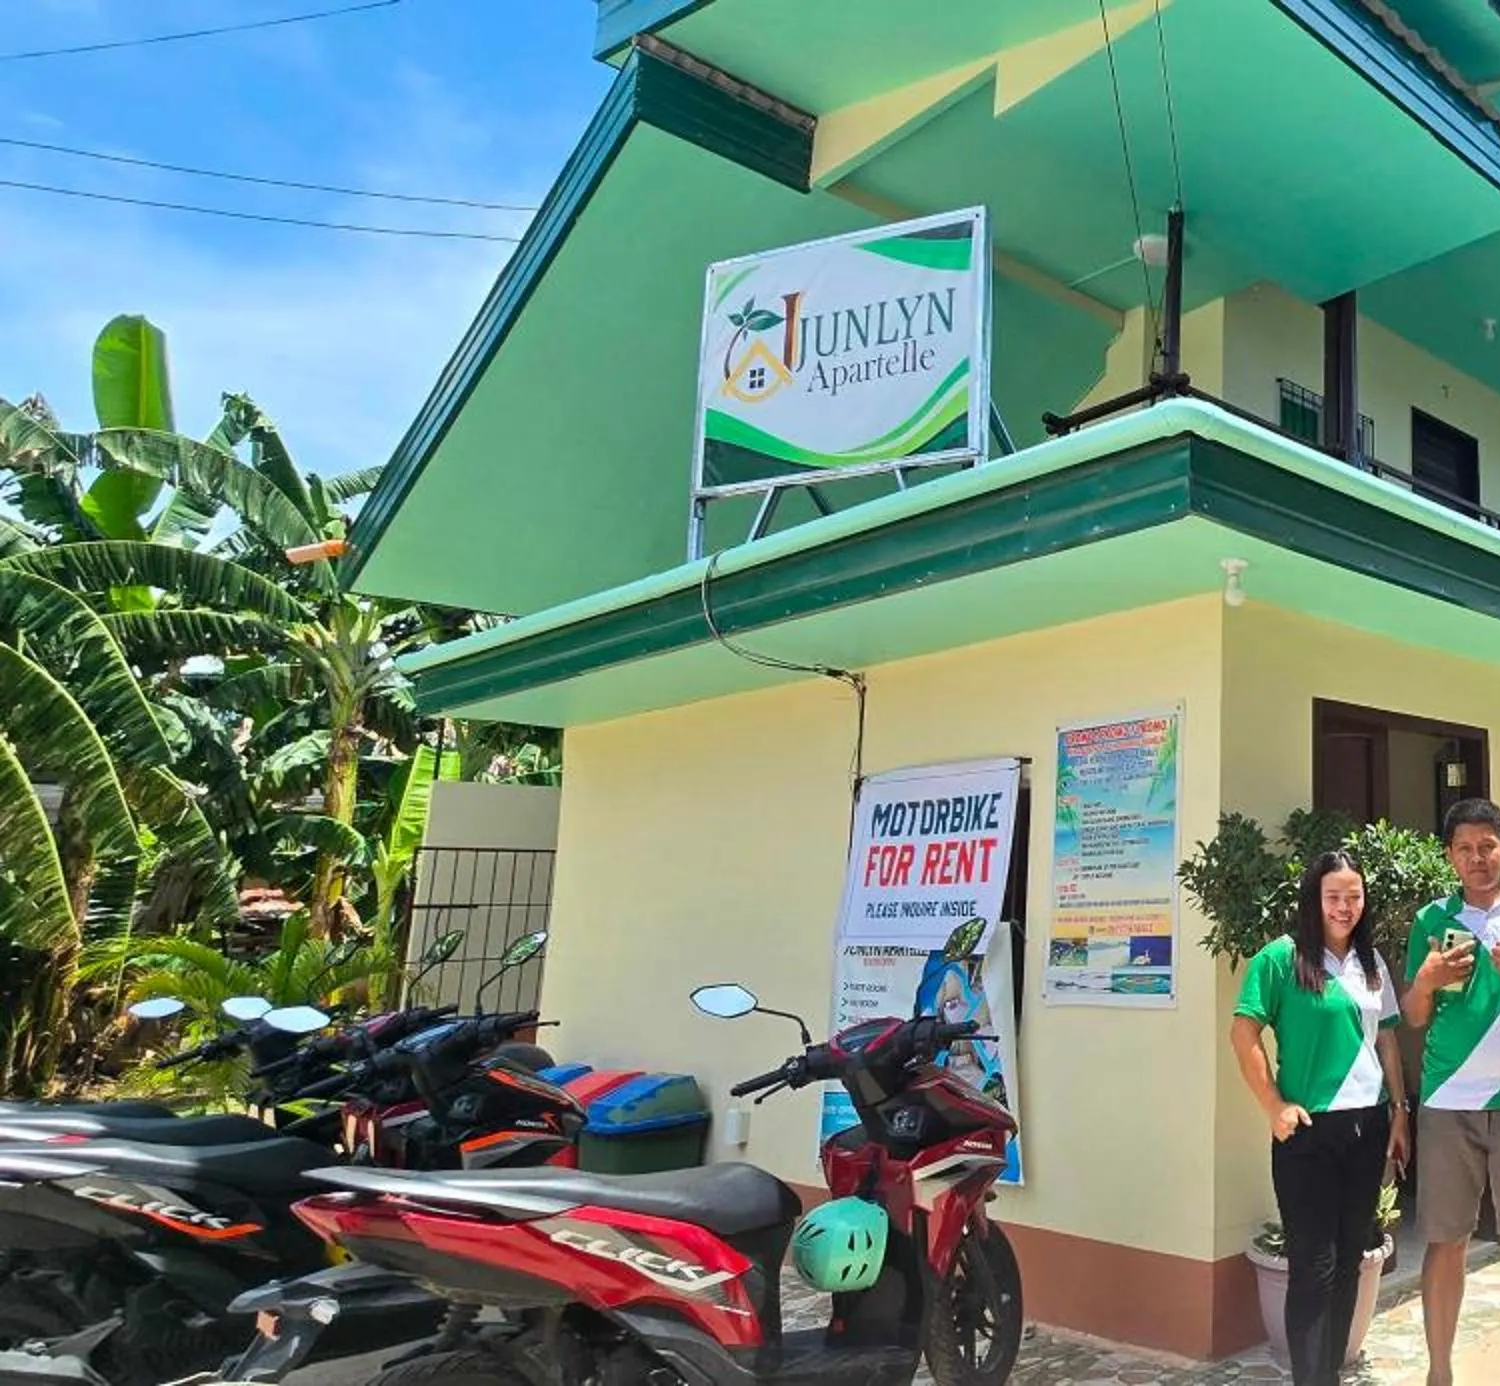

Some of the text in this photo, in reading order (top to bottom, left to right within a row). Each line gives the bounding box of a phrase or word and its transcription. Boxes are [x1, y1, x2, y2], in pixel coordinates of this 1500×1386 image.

[796, 288, 956, 373] JUNLYN
[807, 340, 935, 396] Apartelle
[871, 792, 1003, 838] MOTORBIKE
[863, 838, 997, 888] FOR RENT
[865, 900, 977, 919] PLEASE INQUIRE INSIDE
[74, 1186, 232, 1230] CLICK
[550, 1230, 705, 1280] CLICK
